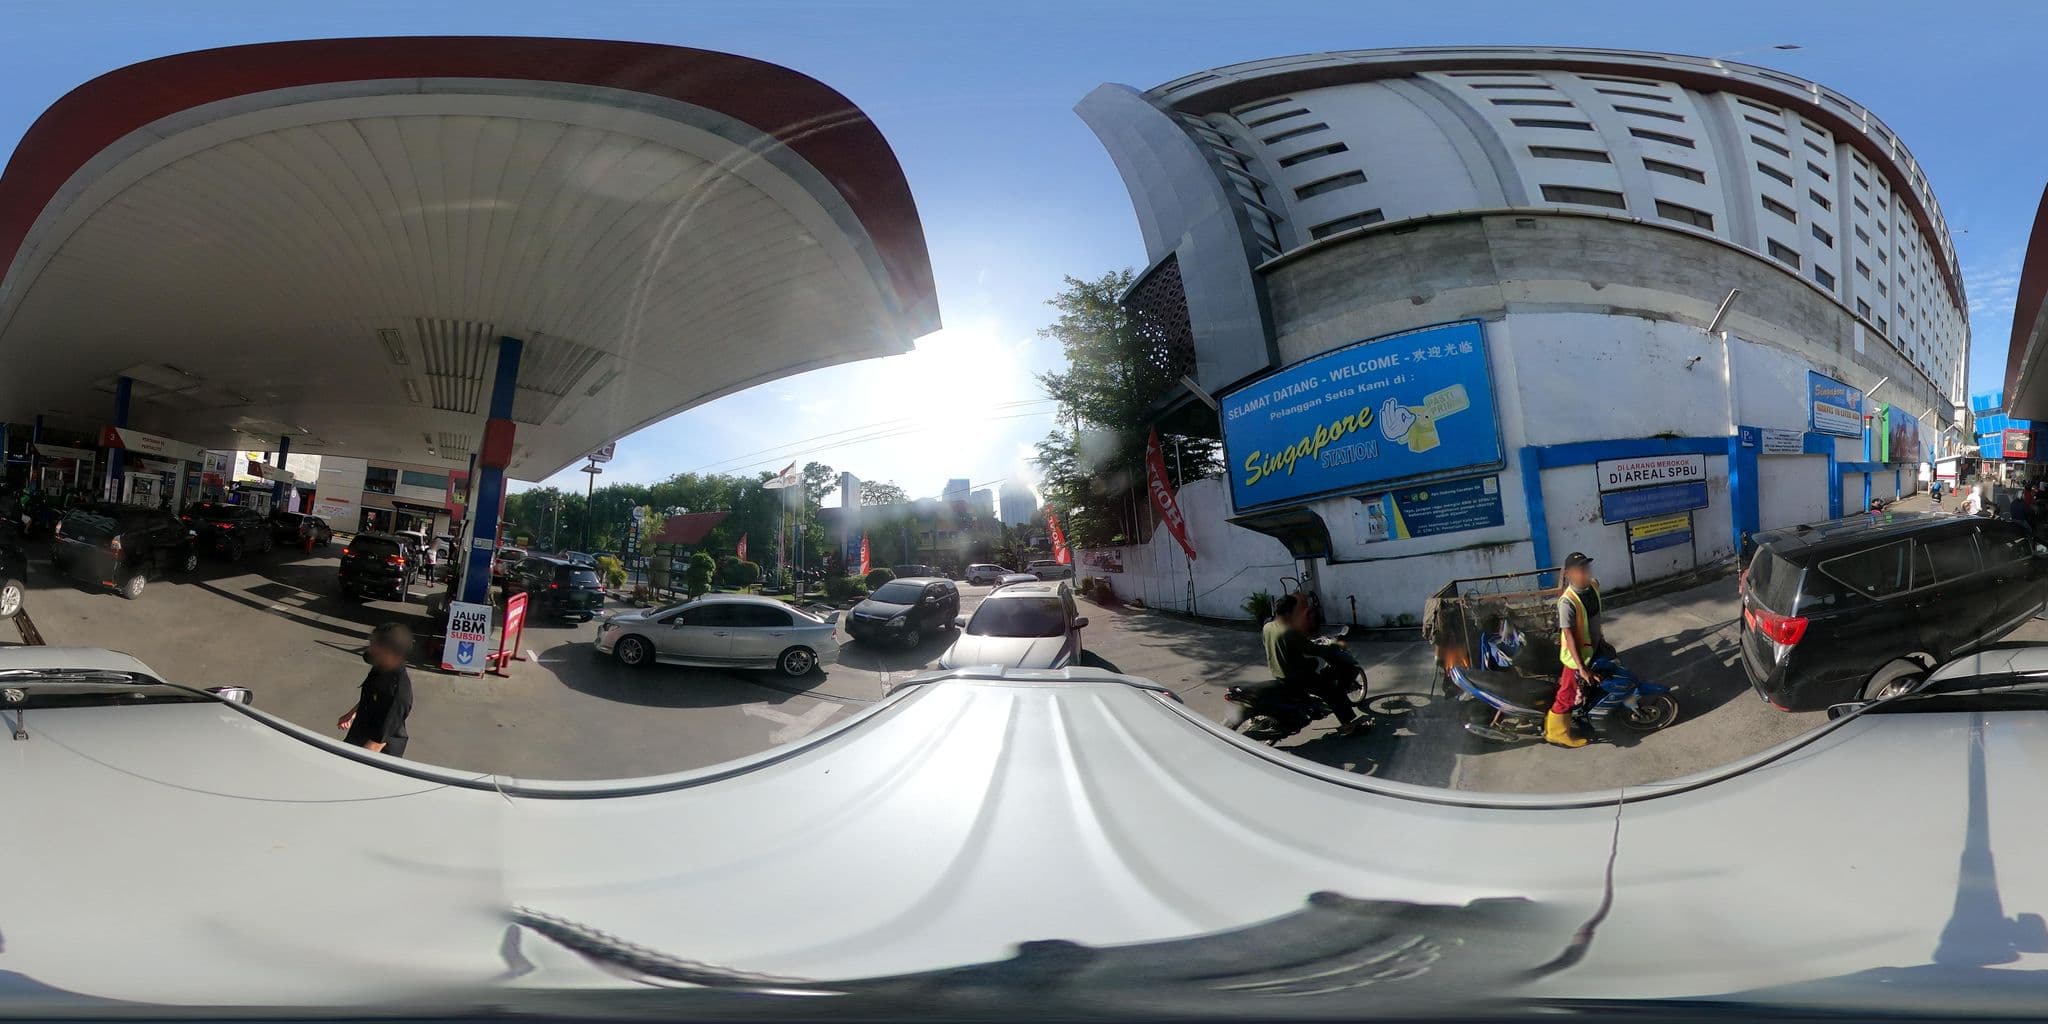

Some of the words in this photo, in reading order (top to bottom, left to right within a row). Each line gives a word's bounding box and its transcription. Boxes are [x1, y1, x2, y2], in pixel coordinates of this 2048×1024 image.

[1228, 394, 1271, 420] SELAMAT
[1273, 377, 1319, 402] DATANG
[1329, 353, 1400, 382] WELCOME
[1412, 341, 1473, 362] 欢迎光临
[1270, 398, 1322, 420] Pelanggan
[1325, 388, 1354, 402] Setia
[1358, 377, 1389, 393] Kami
[1394, 374, 1406, 384] di
[1245, 406, 1374, 486] Singapore
[1320, 440, 1378, 469] STATION
[1656, 459, 1690, 468] MEROKOK
[1609, 472, 1622, 484] DI
[1625, 468, 1665, 482] AREAL
[1668, 465, 1697, 477] SPBU
[454, 611, 486, 622] JALUR
[452, 619, 485, 634] BBM
[451, 631, 486, 642] SUBSIDI
